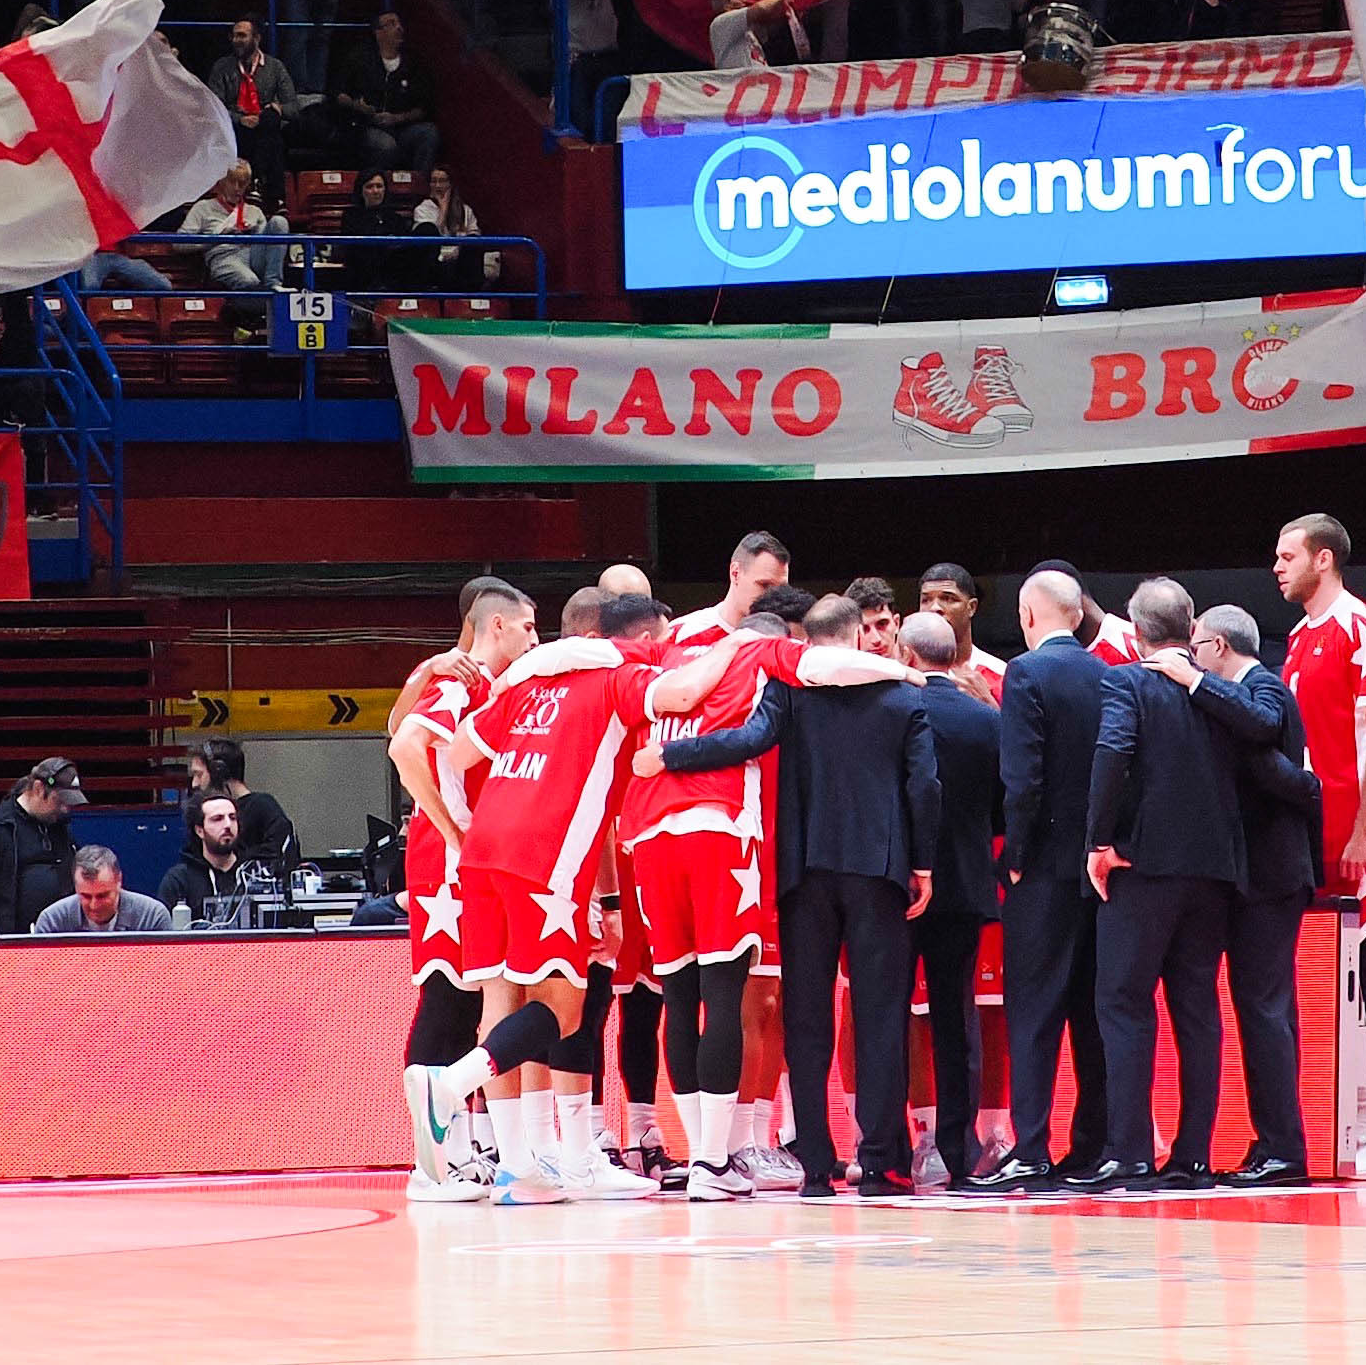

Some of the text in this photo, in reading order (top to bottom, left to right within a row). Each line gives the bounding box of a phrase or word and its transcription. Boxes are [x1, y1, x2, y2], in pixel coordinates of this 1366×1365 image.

[1112, 36, 1355, 96] SIAMO
[296, 296, 325, 317] 15
[306, 334, 317, 347] B
[412, 361, 842, 437] MILANO
[1246, 394, 1285, 410] MILANO
